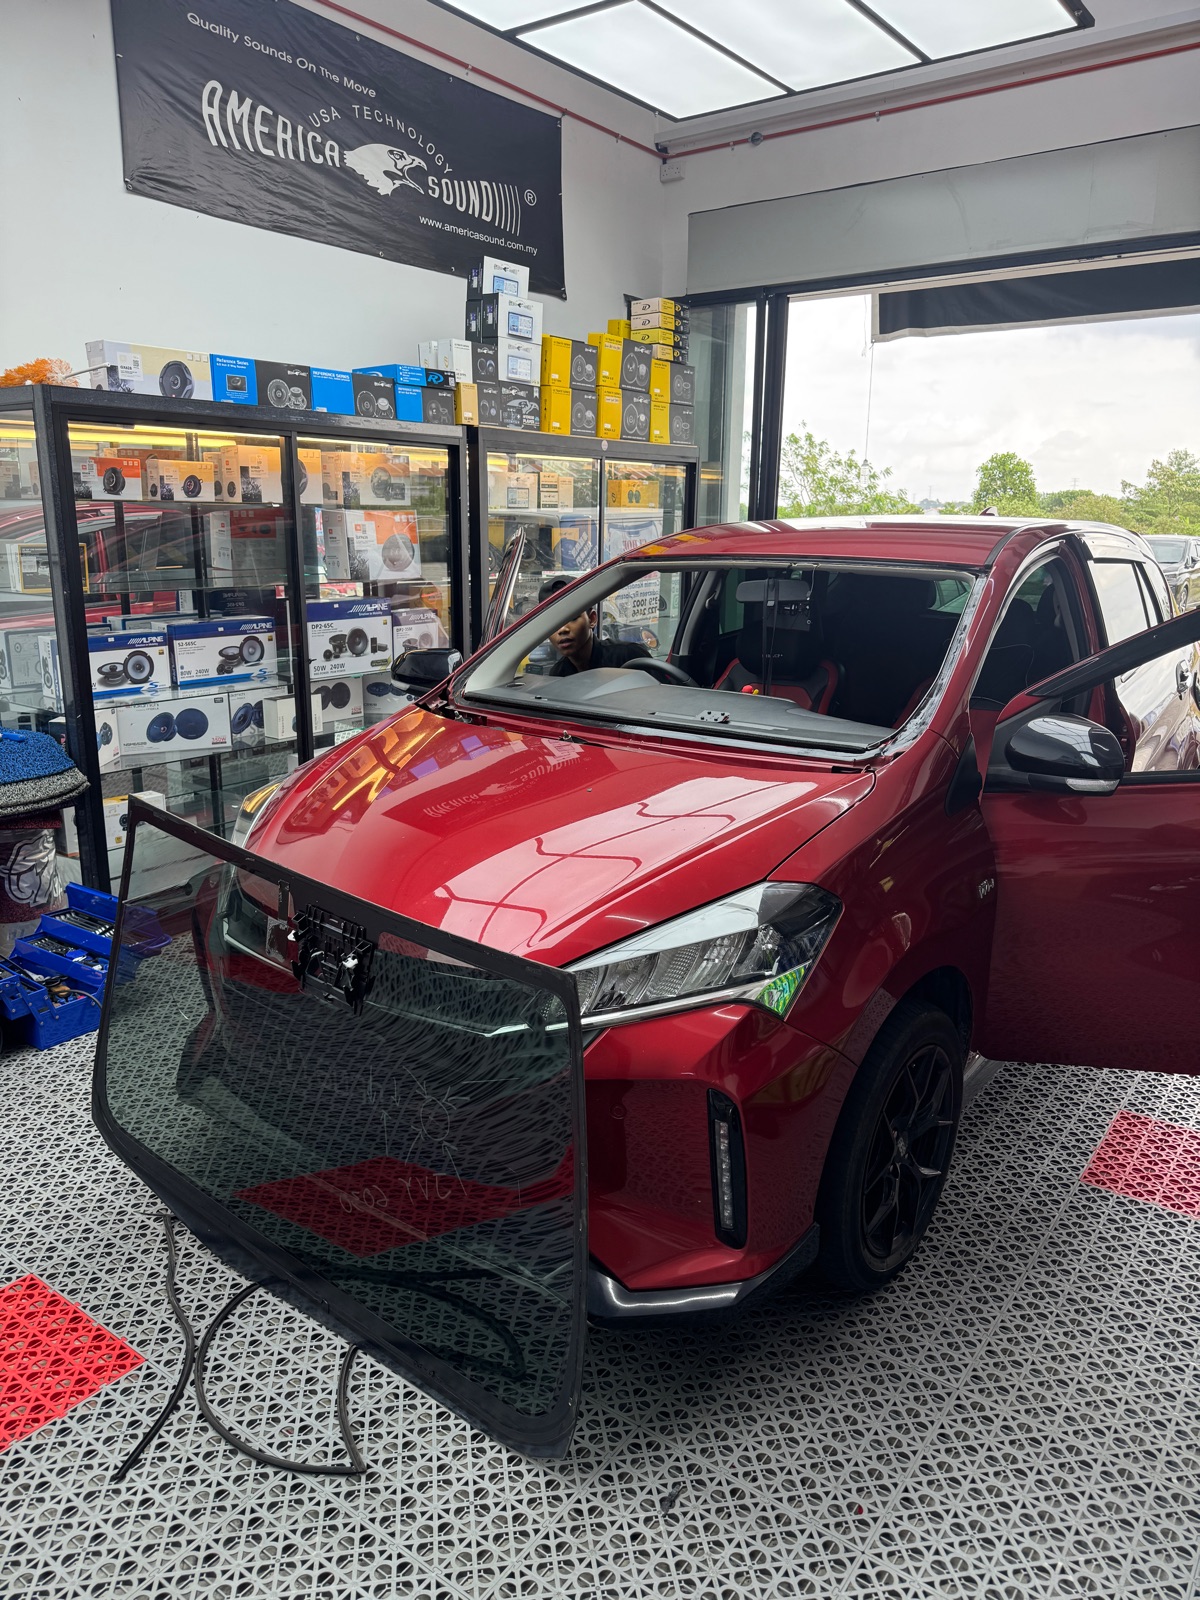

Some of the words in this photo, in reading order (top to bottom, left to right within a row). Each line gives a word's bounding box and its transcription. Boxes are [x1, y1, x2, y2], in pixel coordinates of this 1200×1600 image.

[187, 12, 239, 43] Quality
[244, 35, 293, 64] Sounds
[296, 57, 317, 73] On
[319, 66, 340, 83] The
[343, 77, 377, 98] Move
[202, 80, 340, 167] AMERICA
[309, 107, 341, 127] USA
[352, 104, 453, 174] TECHNOLOGY
[427, 175, 499, 225] SOUND
[419, 215, 538, 256] www.americasound.com.my
[355, 602, 389, 612] ALPINE
[245, 621, 273, 631] ALPINE
[311, 622, 334, 630] DP2-65C
[133, 635, 164, 646] ALPINE
[313, 665, 327, 673] 50W
[330, 662, 346, 671] 240W
